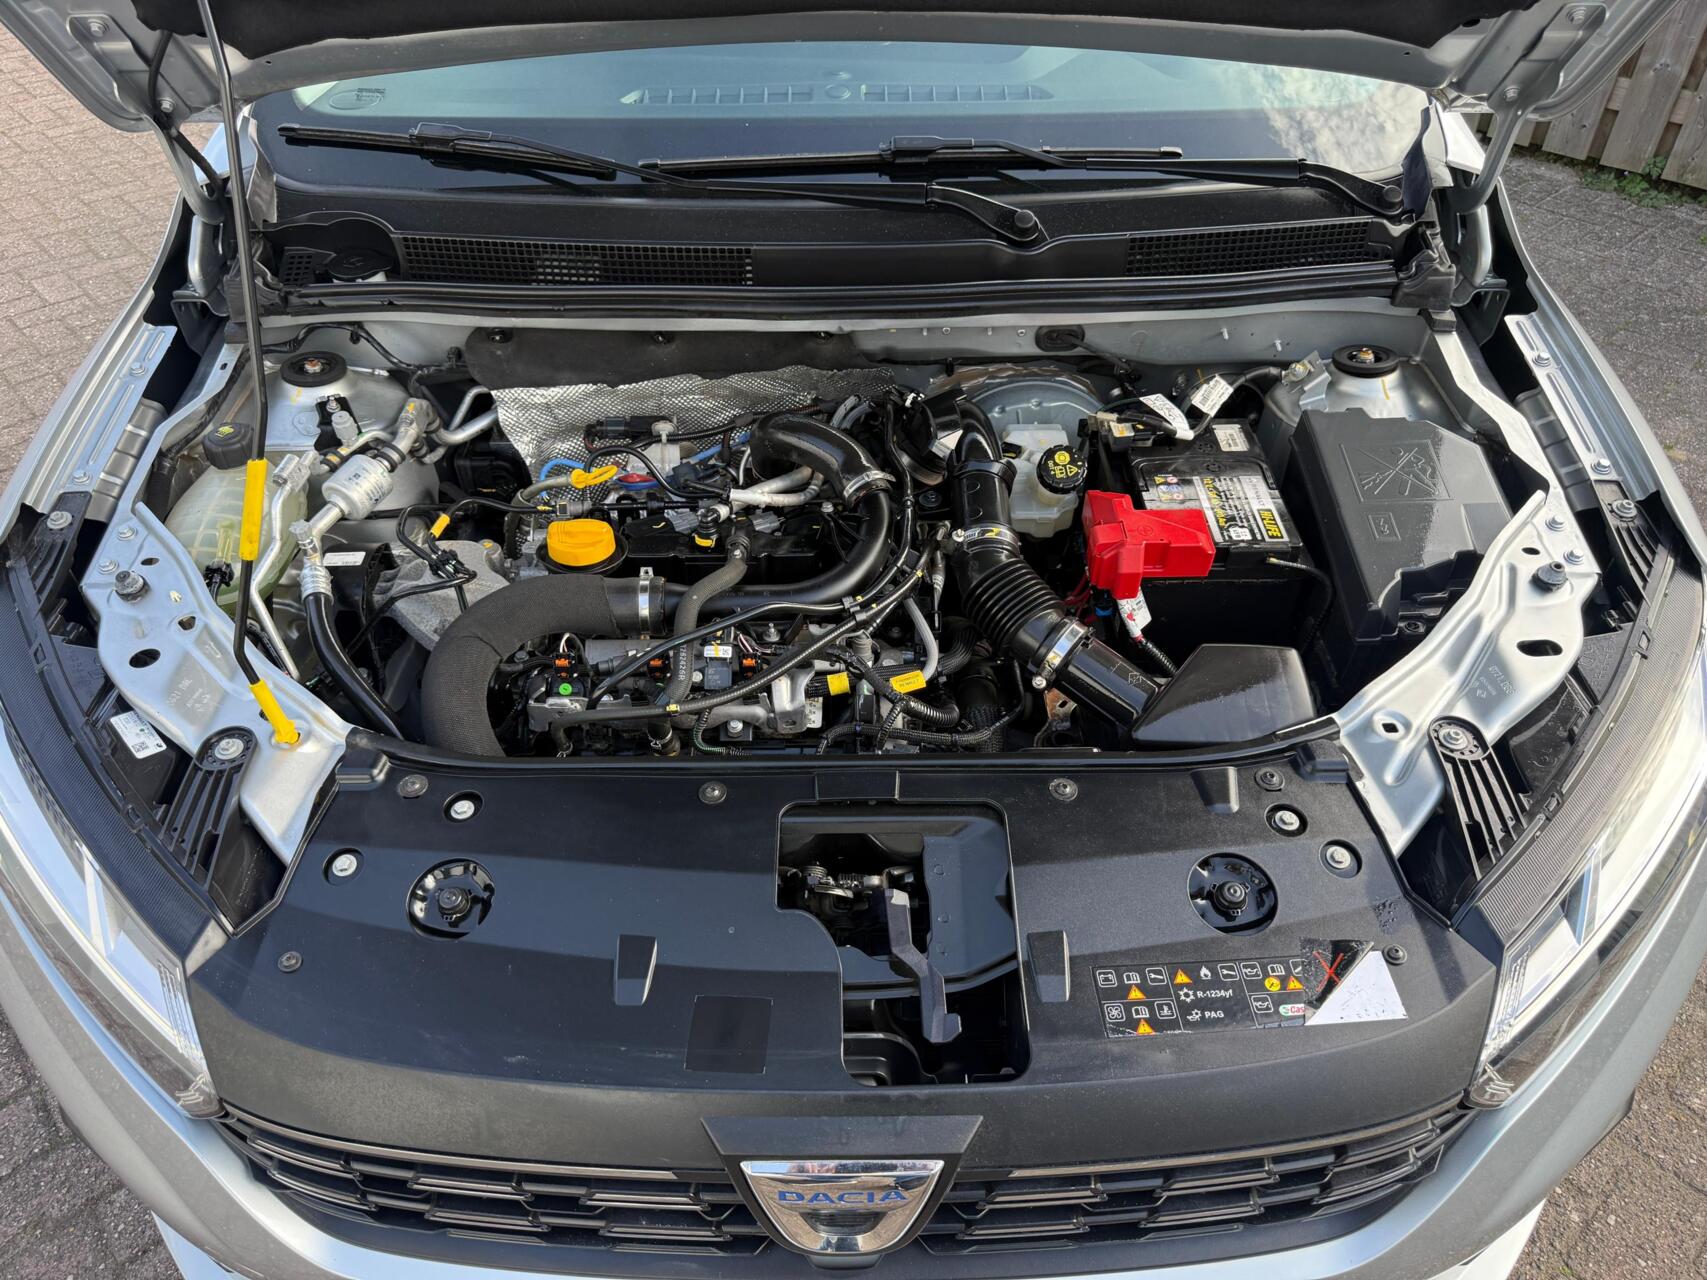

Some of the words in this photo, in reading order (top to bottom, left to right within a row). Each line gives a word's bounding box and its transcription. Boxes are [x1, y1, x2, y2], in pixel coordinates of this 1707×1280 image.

[1196, 988, 1233, 999] R-1234yf
[1204, 1010, 1225, 1019] PAG
[777, 1190, 907, 1204] DACIA
